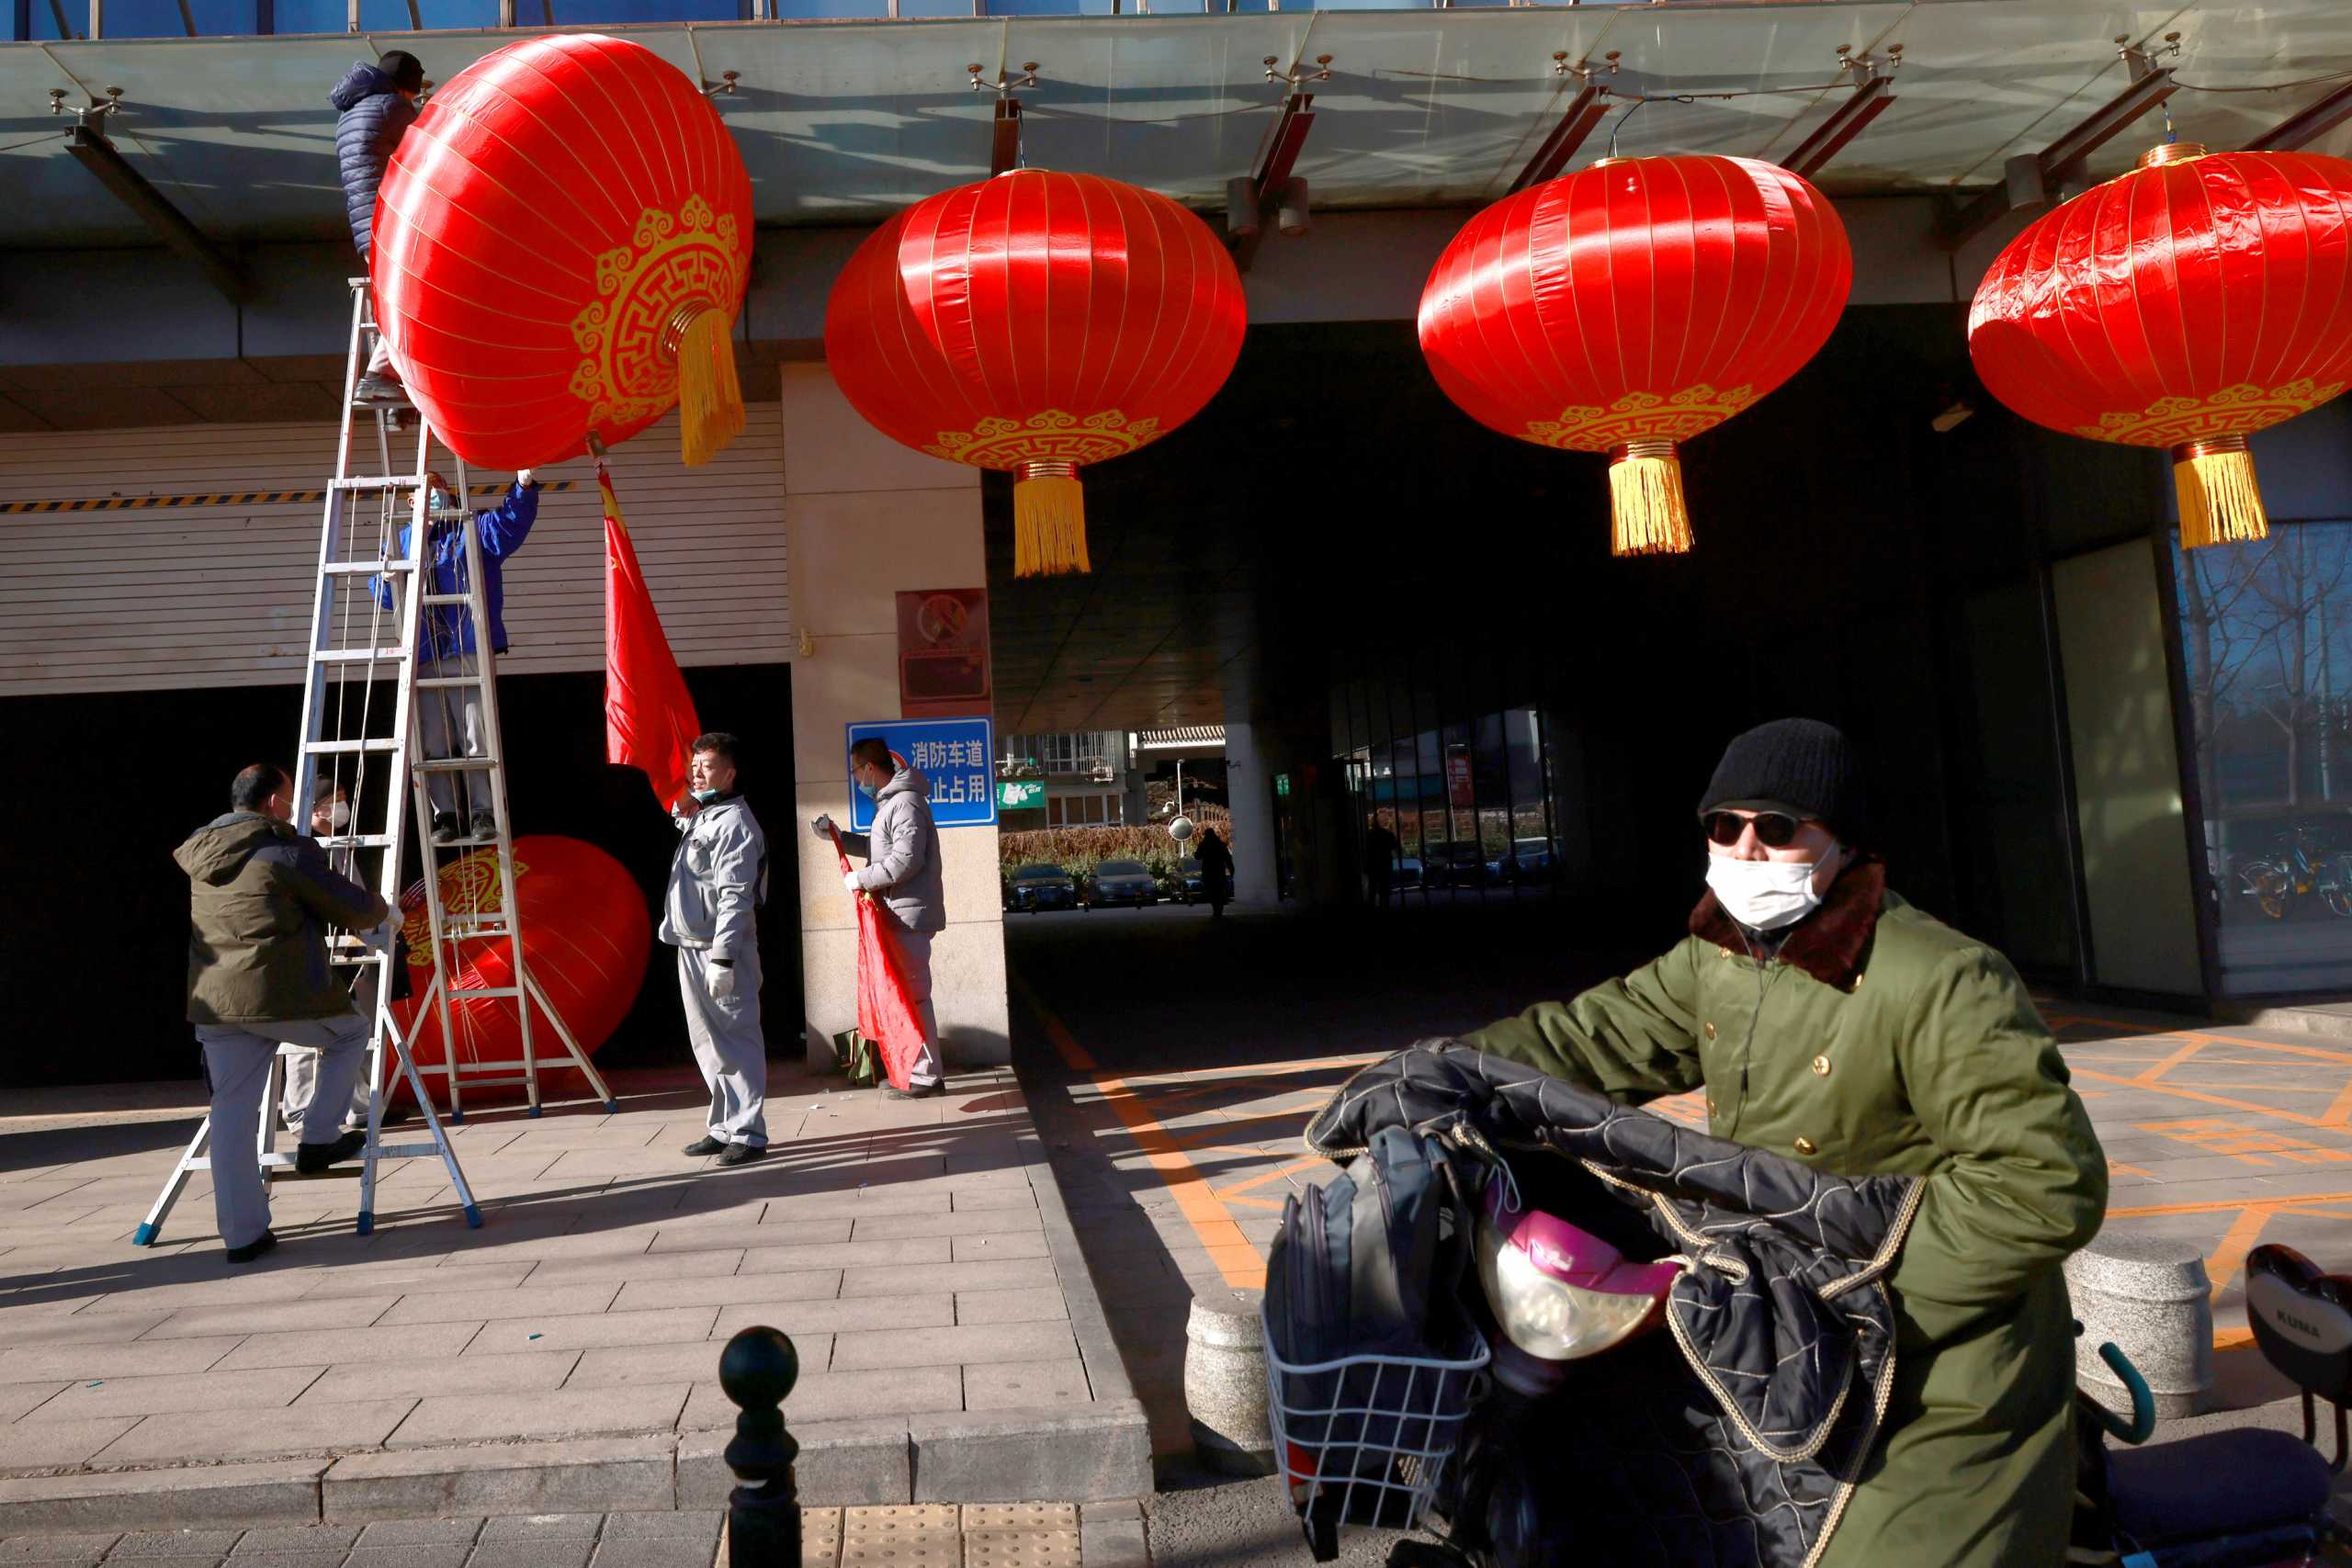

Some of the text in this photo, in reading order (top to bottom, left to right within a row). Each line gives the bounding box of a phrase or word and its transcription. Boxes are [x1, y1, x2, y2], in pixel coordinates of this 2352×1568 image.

[911, 739, 984, 769] 消防车道
[923, 774, 986, 804] 止占用
